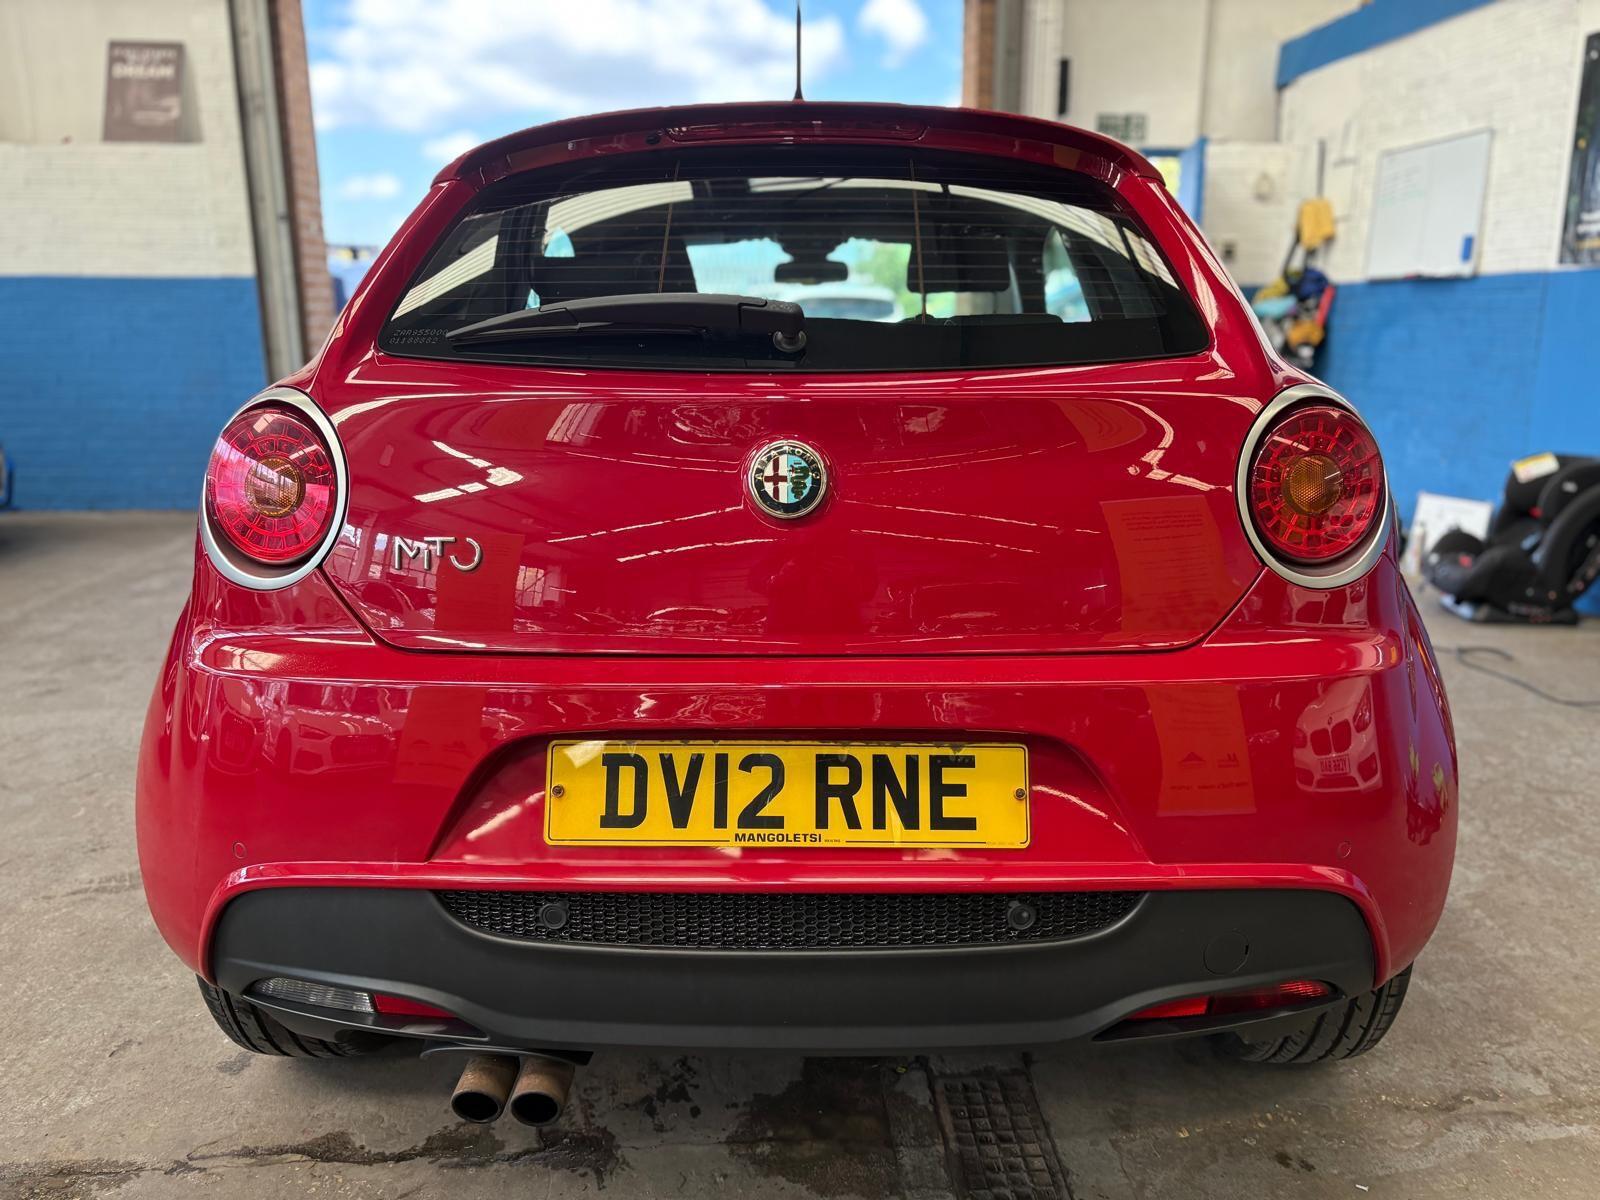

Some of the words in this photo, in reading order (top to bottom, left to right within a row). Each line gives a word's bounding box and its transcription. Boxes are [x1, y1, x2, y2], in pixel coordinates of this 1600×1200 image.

[600, 753, 785, 829] DV12
[815, 754, 977, 830] RNE
[734, 832, 822, 843] MANGOLETSI
